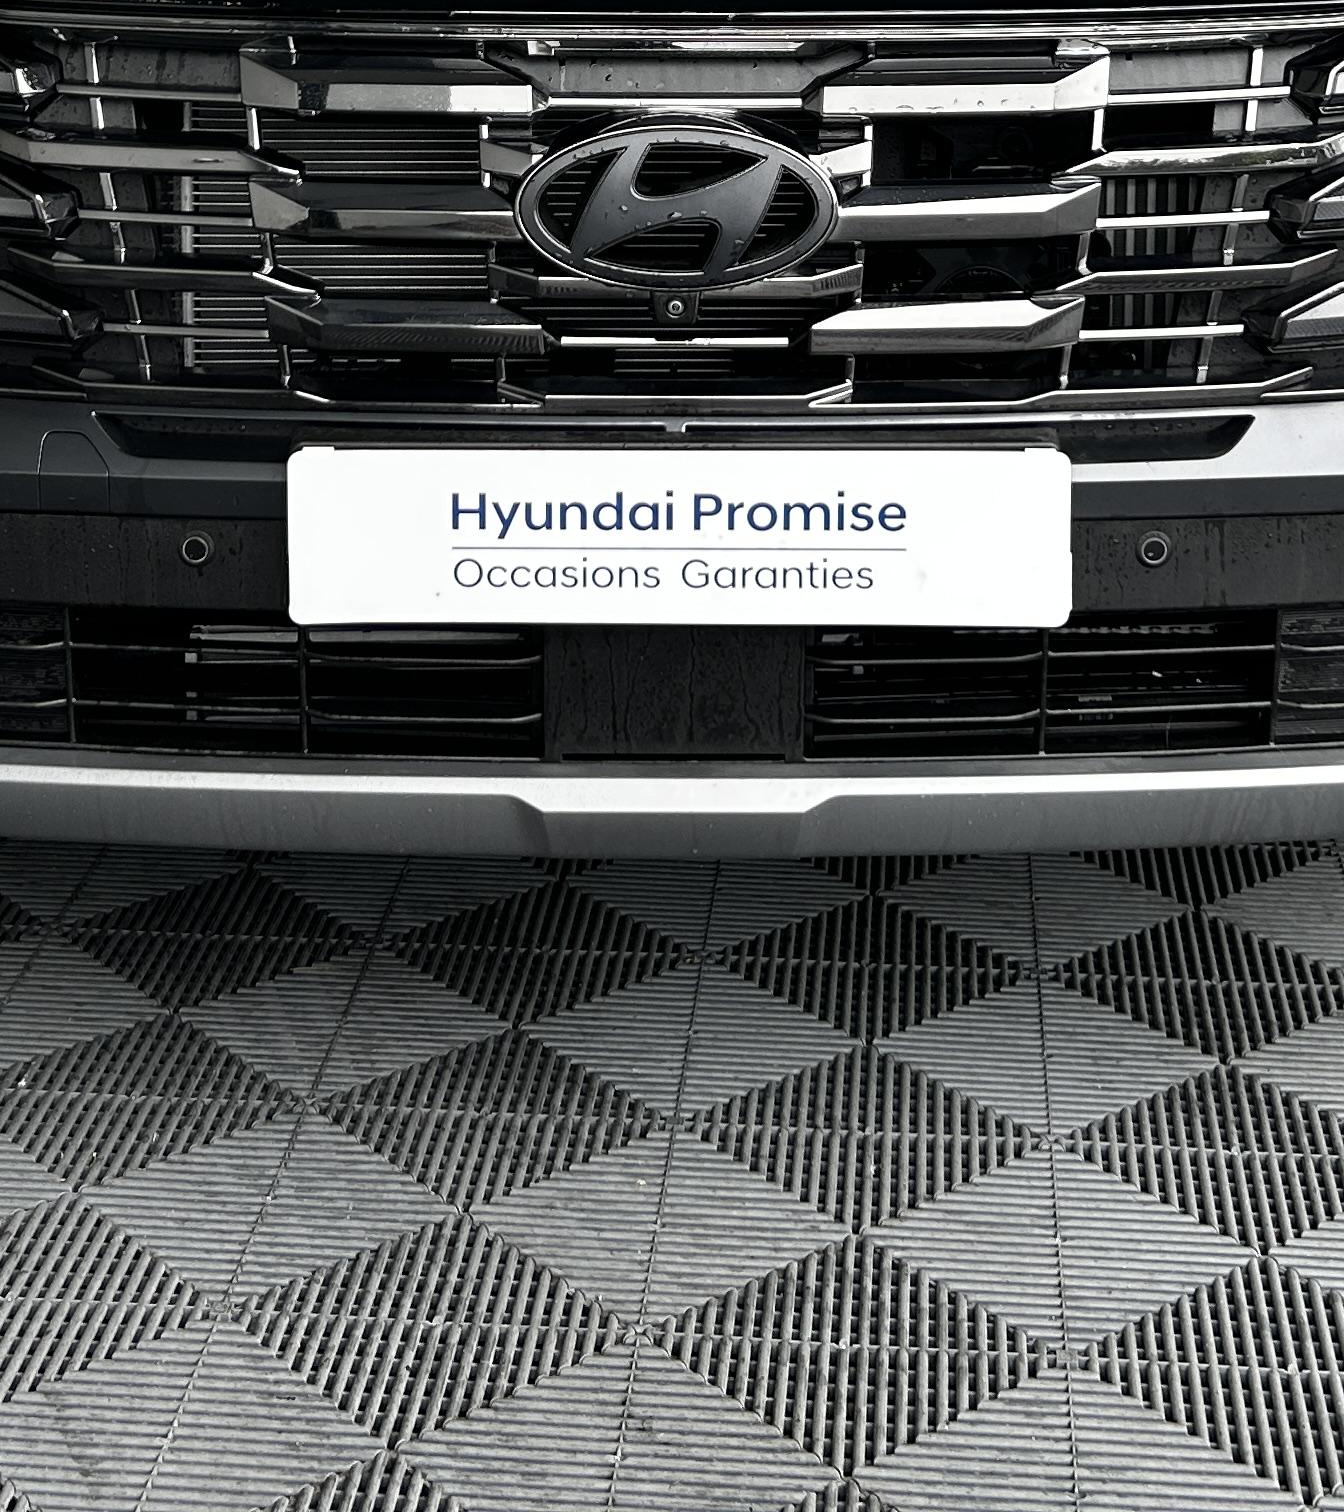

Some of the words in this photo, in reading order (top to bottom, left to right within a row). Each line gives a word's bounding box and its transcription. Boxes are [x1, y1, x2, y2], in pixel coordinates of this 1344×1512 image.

[452, 490, 674, 539] Hyundai
[694, 491, 907, 532] Promise
[453, 557, 661, 589] Occasions
[682, 558, 874, 590] Garanties
